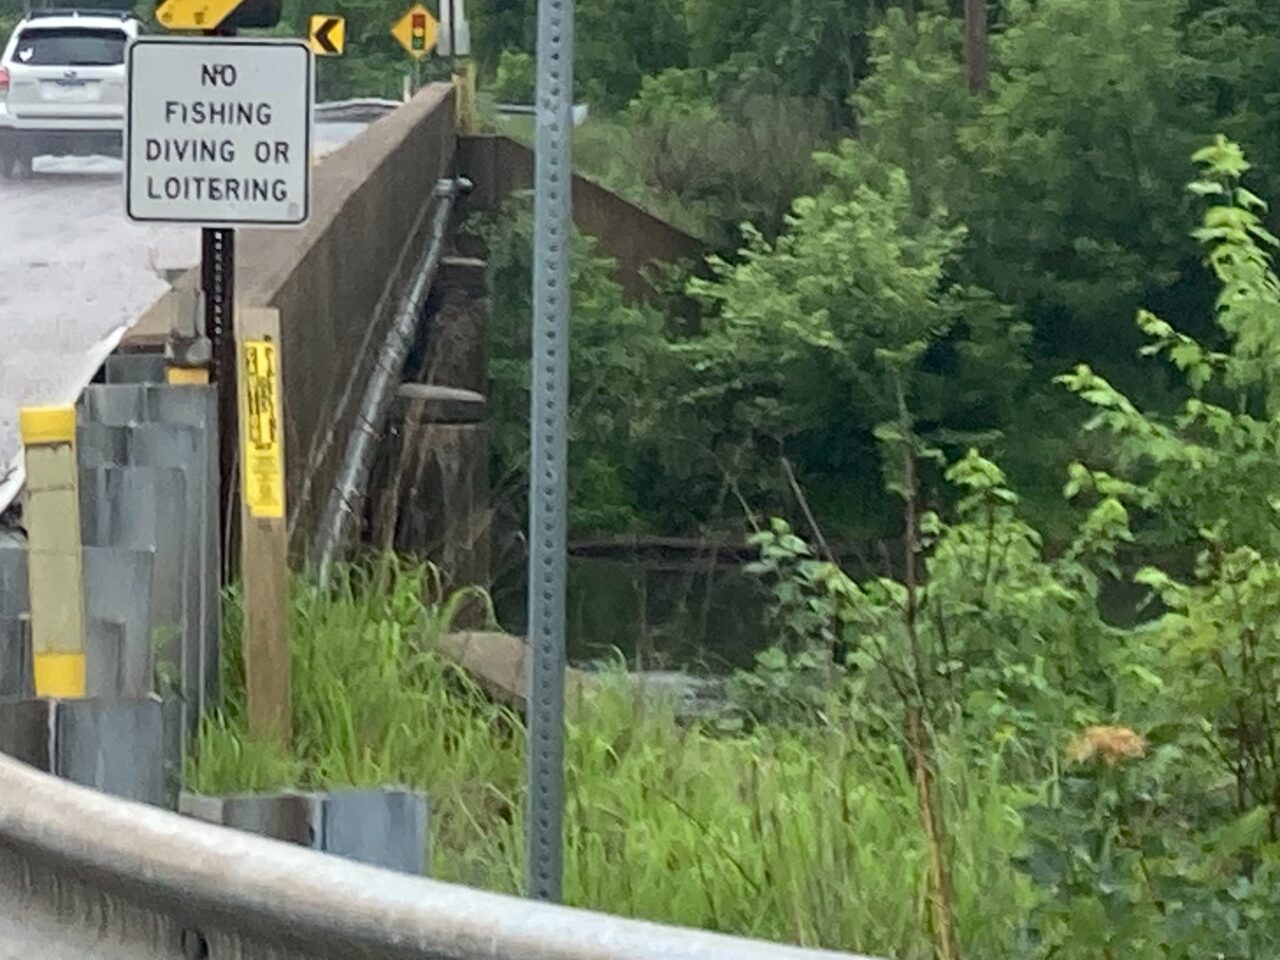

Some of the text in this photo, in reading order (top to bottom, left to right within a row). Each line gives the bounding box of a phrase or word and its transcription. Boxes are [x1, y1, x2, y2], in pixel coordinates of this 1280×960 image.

[200, 63, 237, 87] NO
[165, 100, 272, 126] FISHING
[146, 138, 290, 164] DIVING OR
[147, 176, 287, 203] LOITERING
